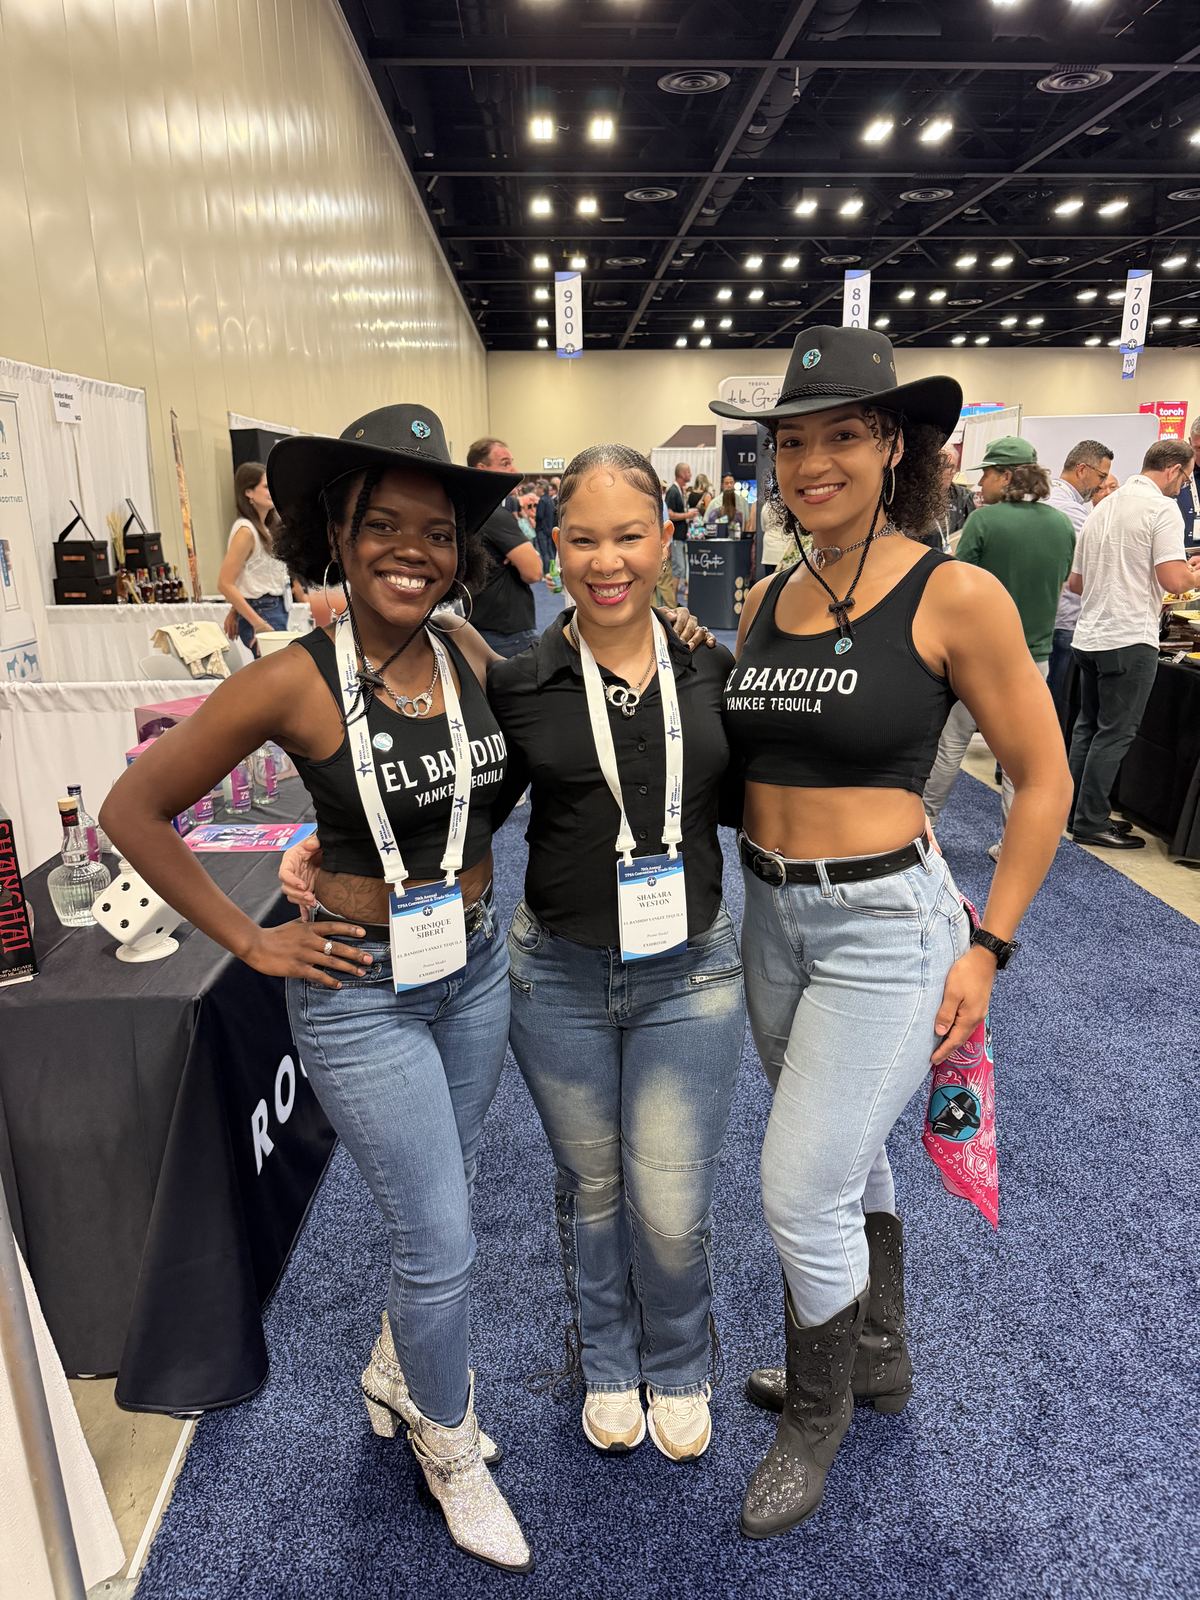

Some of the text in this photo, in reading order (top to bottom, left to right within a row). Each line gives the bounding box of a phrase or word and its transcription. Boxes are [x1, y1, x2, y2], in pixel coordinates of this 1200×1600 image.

[563, 289, 574, 335] 900
[851, 287, 861, 328] 800
[1130, 287, 1142, 331] 700
[751, 387, 781, 409] Gent
[1158, 407, 1184, 416] torch
[543, 458, 564, 469] EXIT
[738, 666, 858, 695] BANDIDO
[726, 696, 822, 713] YANKEE TEQUILA
[380, 760, 419, 793] EL
[419, 730, 508, 783] BADID
[415, 767, 504, 808] YANKE EQUILA
[636, 890, 672, 902] SHAKARA
[639, 898, 670, 908] WESTON
[410, 918, 452, 933] VERNIQUE
[417, 927, 445, 940] SIBERT
[251, 1054, 308, 1177] RO
